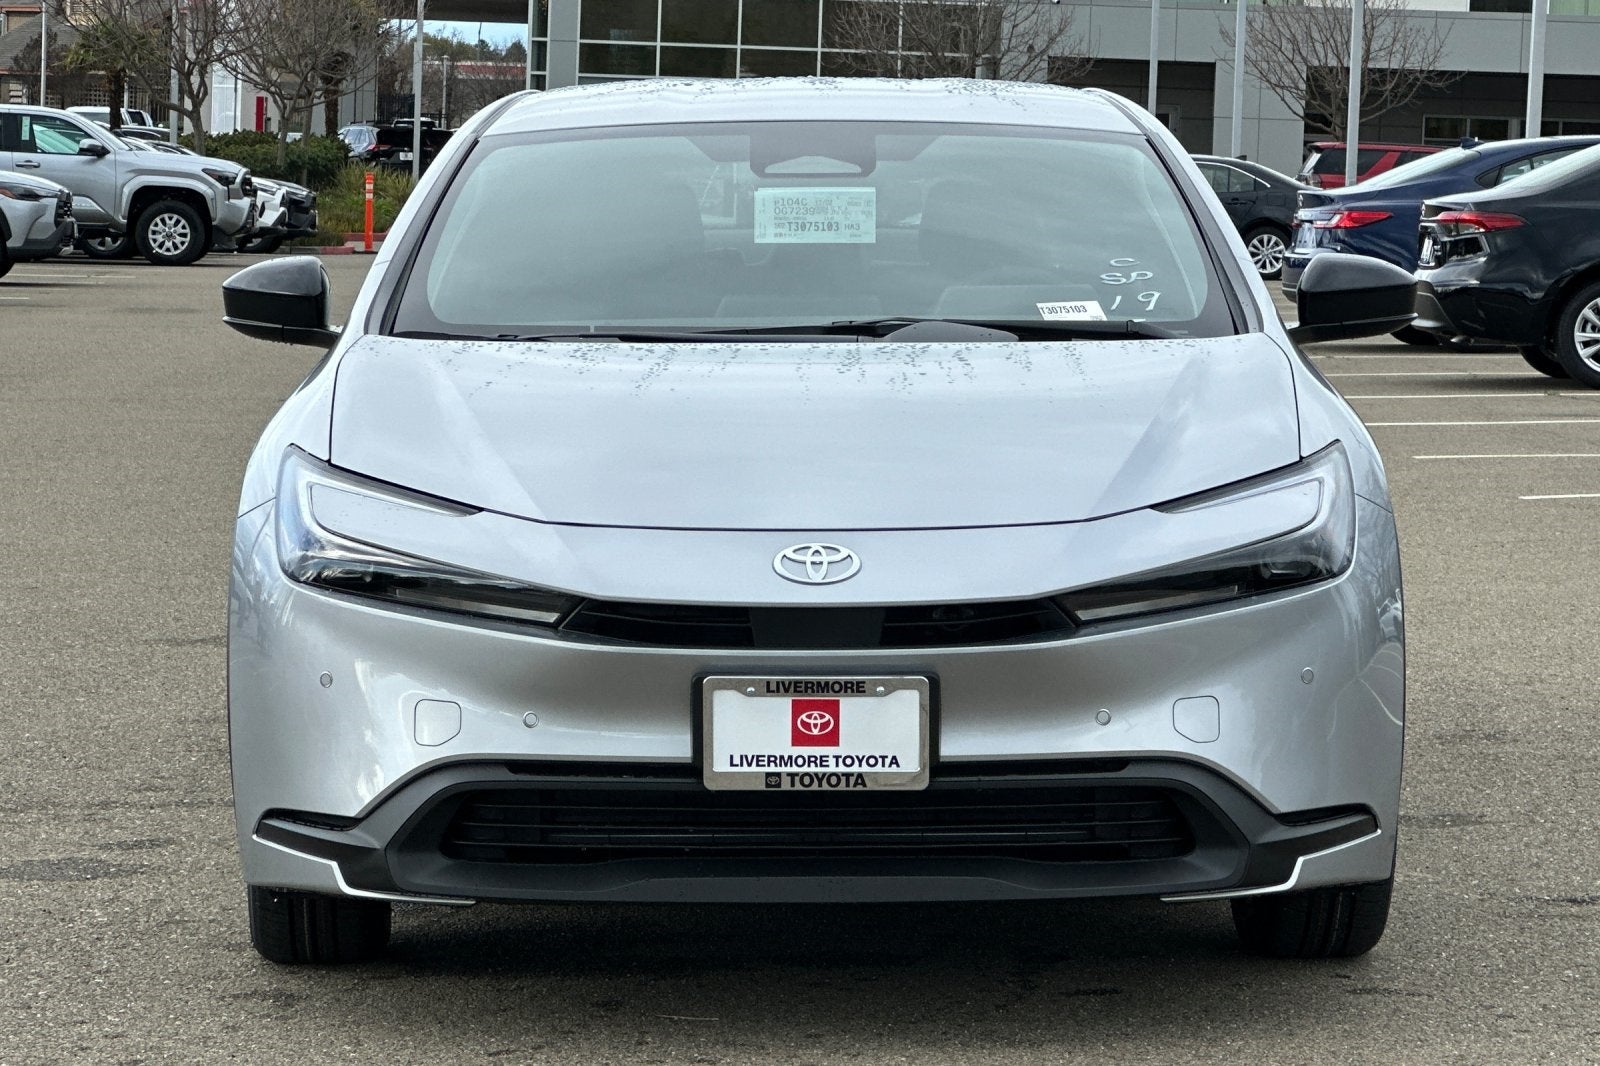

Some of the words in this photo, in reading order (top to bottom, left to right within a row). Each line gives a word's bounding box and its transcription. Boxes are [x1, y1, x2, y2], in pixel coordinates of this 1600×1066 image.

[786, 221, 840, 232] T3075103
[1039, 305, 1088, 315] T3075103
[766, 681, 866, 694] LIVERMORE
[729, 754, 830, 768] LIVERMORE
[834, 754, 901, 768] TOYOTA
[786, 772, 867, 788] TOYOTA
